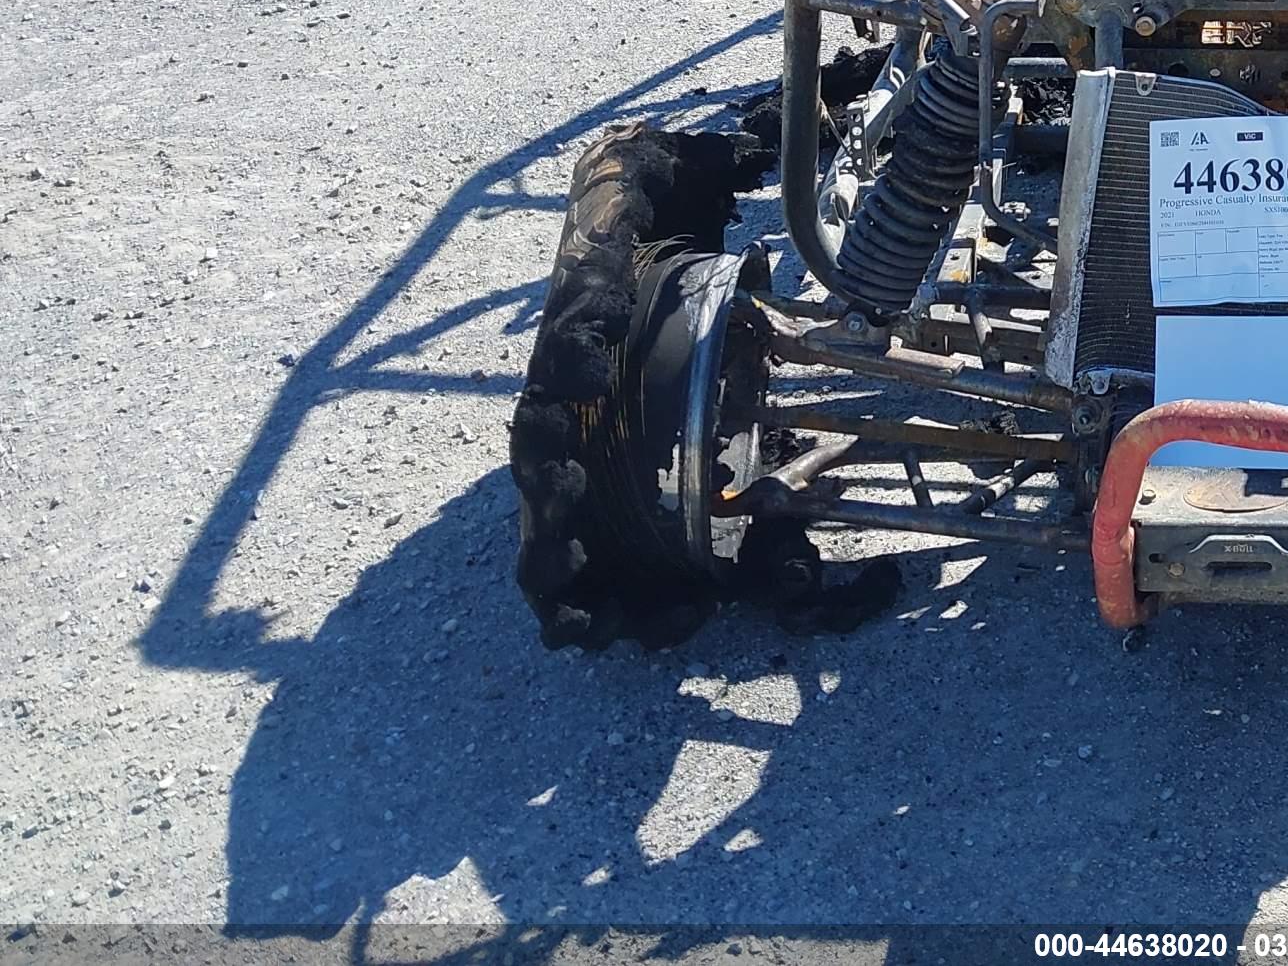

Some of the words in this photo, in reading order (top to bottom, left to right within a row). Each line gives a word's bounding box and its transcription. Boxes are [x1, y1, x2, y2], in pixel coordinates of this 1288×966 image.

[1159, 197, 1213, 210] Progressive
[1215, 194, 1256, 205] Casualty
[1160, 211, 1175, 219] 2021
[1195, 209, 1222, 217] HONDA
